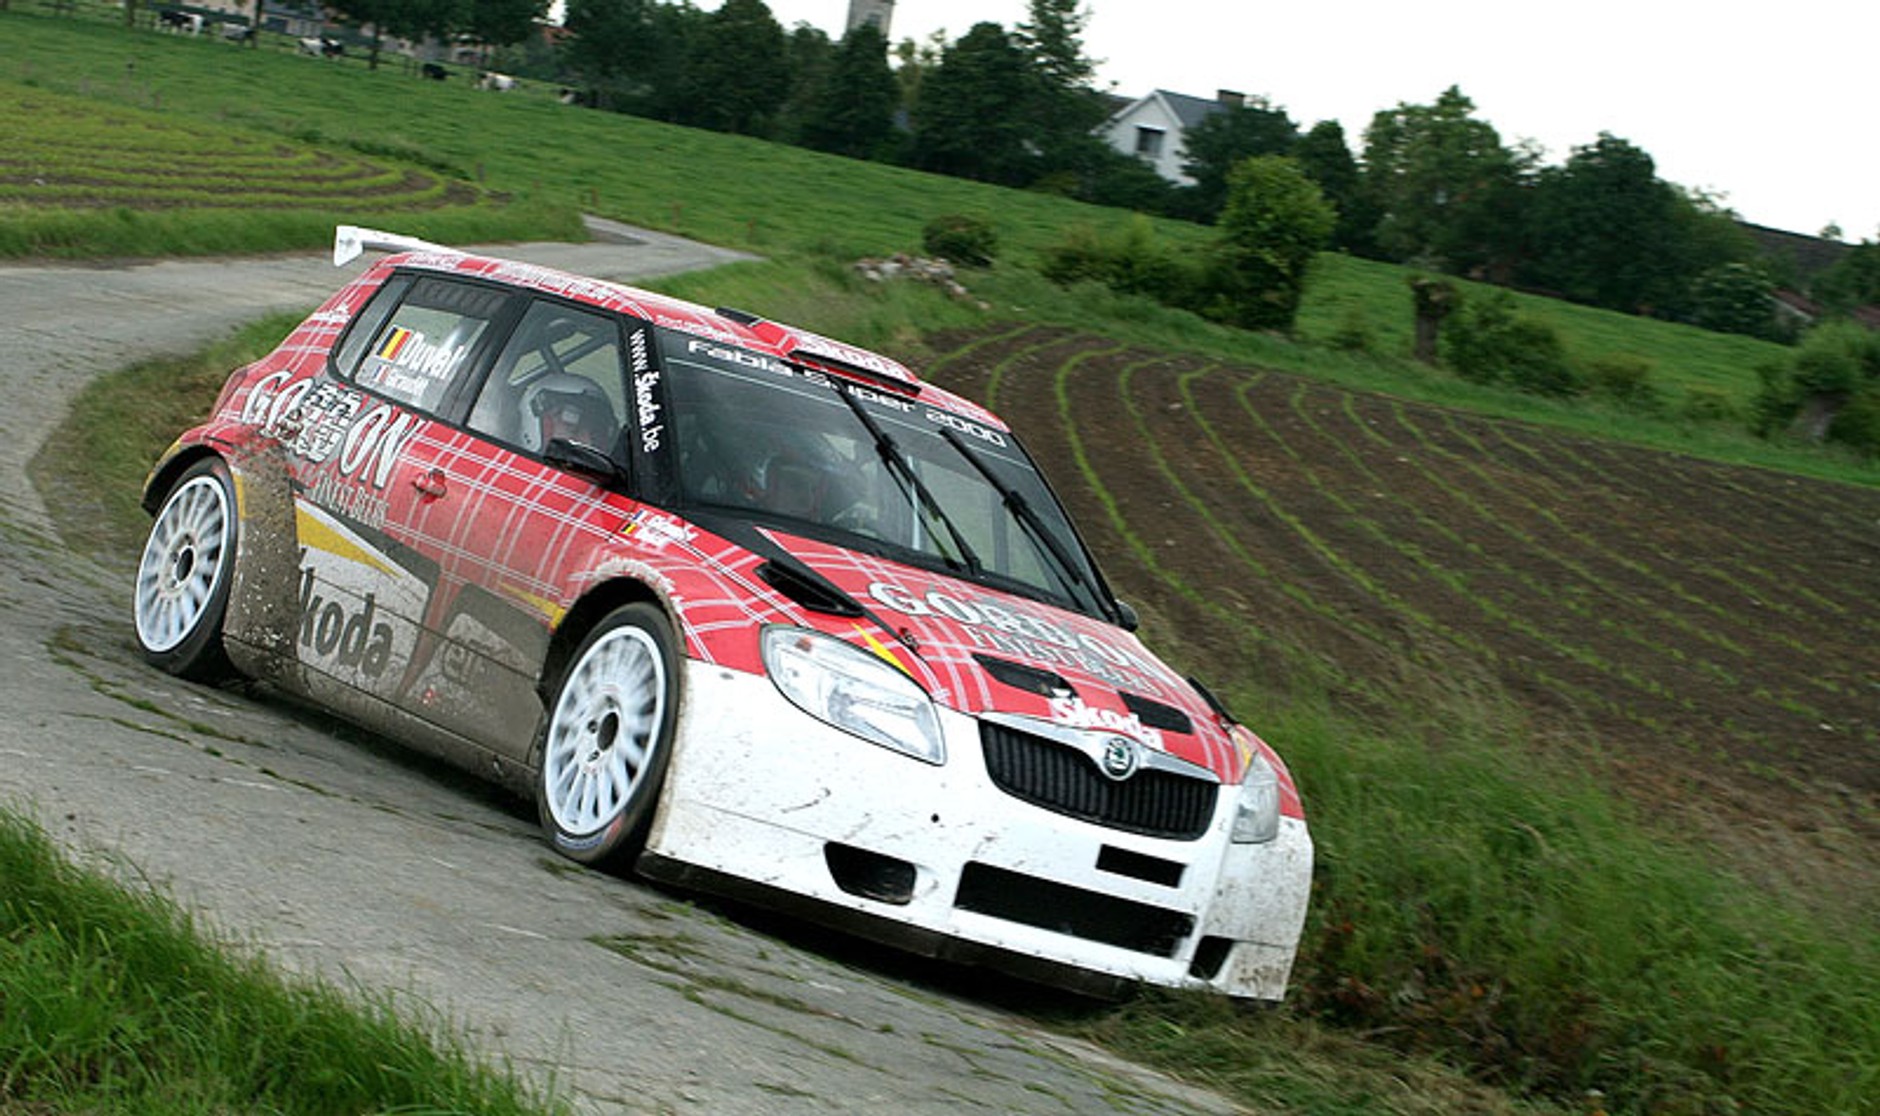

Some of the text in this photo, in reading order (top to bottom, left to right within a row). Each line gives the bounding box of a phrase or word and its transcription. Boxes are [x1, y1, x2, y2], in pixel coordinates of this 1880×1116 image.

[396, 331, 465, 380] Duval
[688, 340, 793, 377] Fabia
[925, 409, 1007, 448] 2000
[298, 560, 395, 668] koda
[867, 580, 1180, 690] GORDON
[1050, 687, 1165, 750] Škoda
